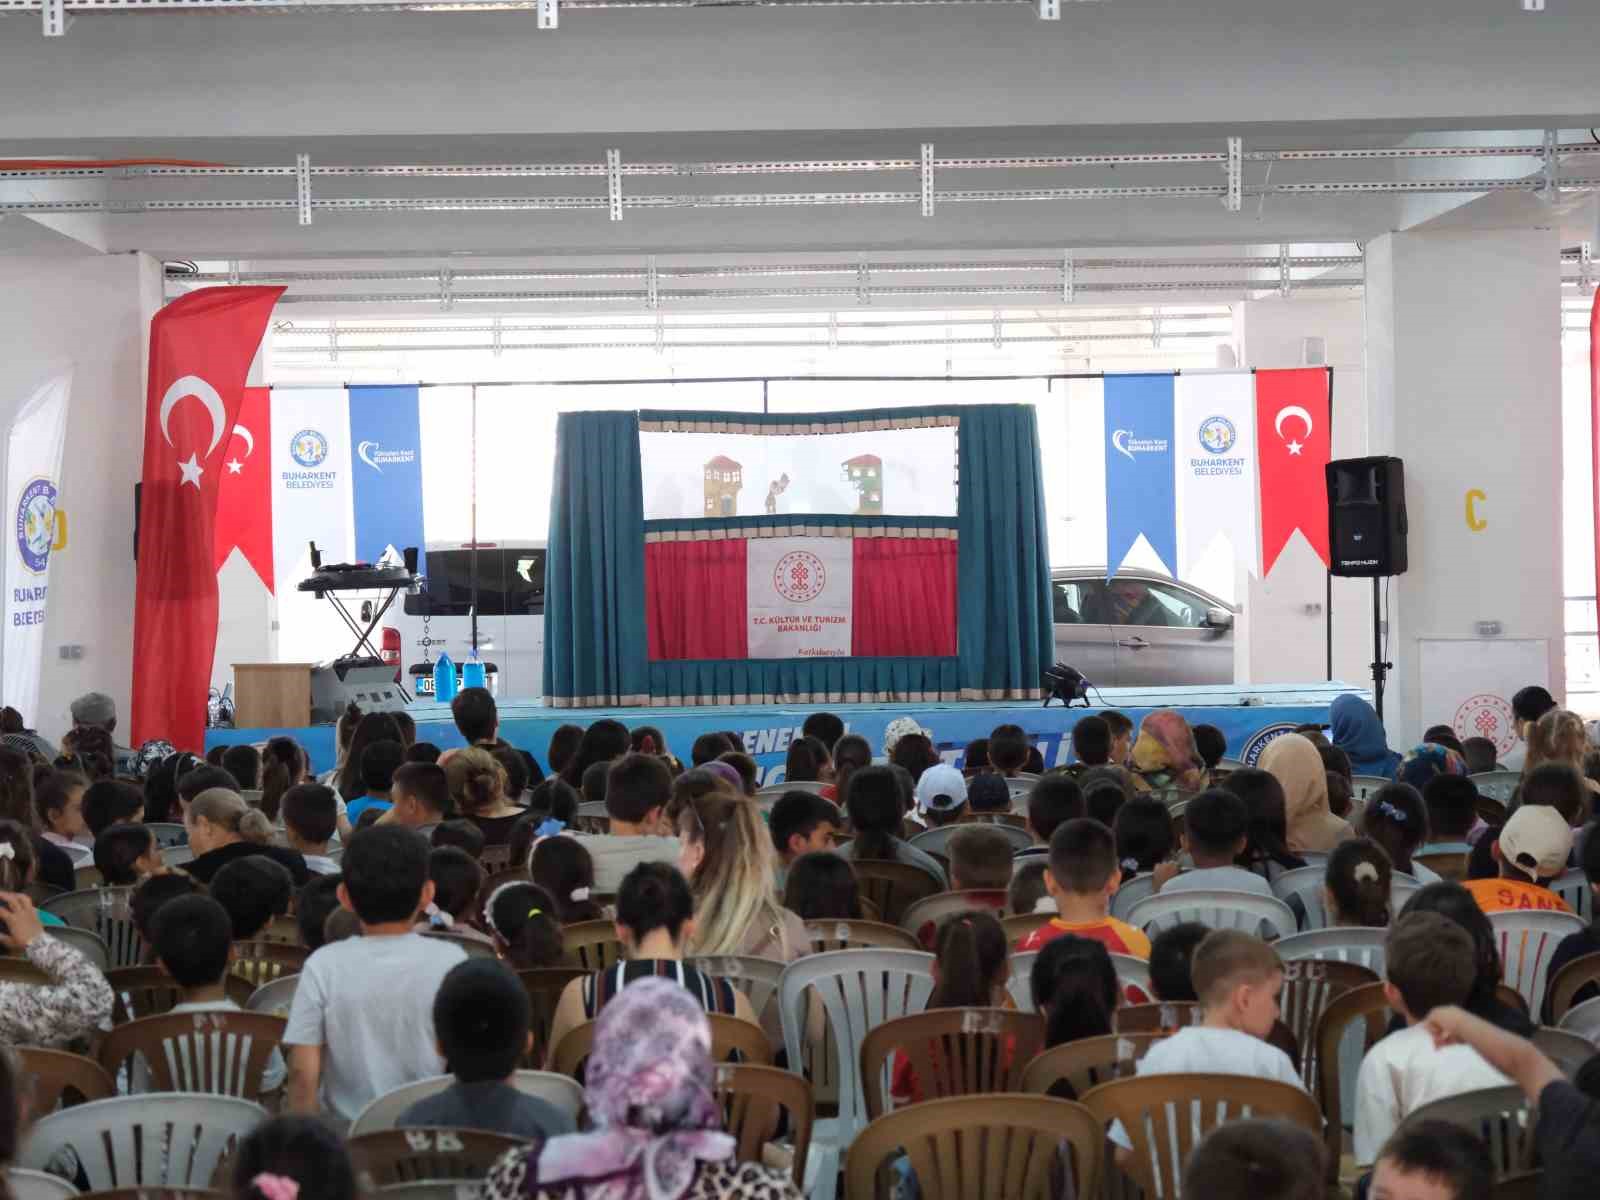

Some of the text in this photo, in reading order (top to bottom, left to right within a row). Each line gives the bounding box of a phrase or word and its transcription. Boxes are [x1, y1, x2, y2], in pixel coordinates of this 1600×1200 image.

[1191, 458, 1245, 467] BUHARKENT
[282, 471, 336, 480] BUHARKENT
[1465, 489, 1487, 532] C
[802, 615, 813, 623] VE
